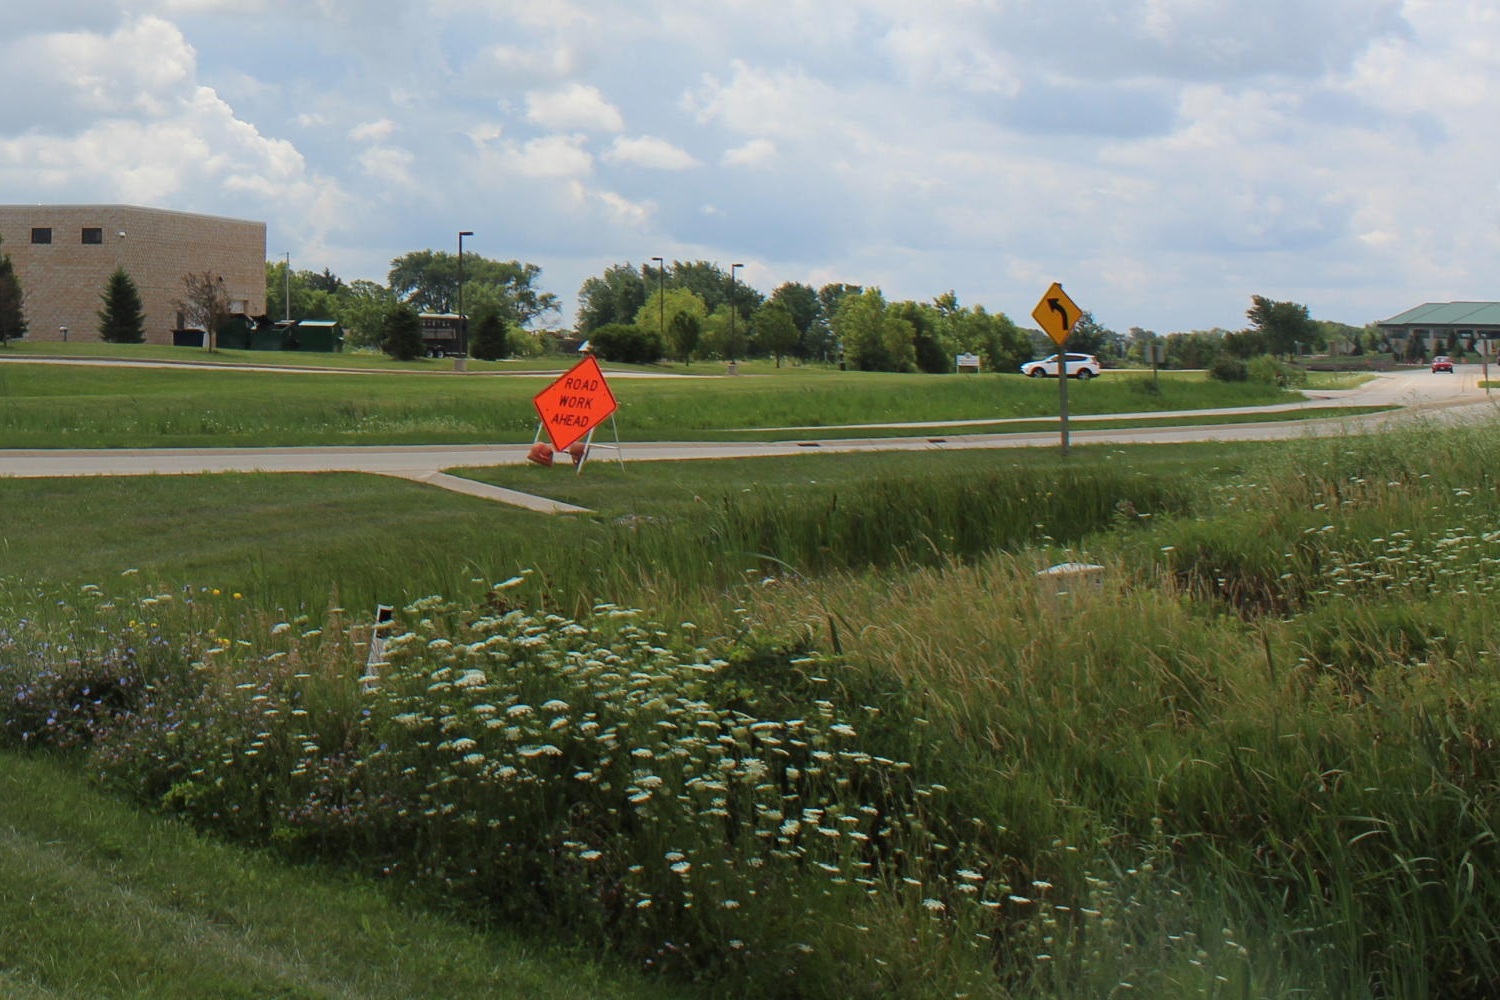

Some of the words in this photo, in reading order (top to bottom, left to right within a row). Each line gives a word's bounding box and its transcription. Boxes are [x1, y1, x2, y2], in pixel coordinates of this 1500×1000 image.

[564, 377, 598, 391] ROAD
[559, 395, 593, 409] WORK
[551, 413, 589, 427] AHEAD
